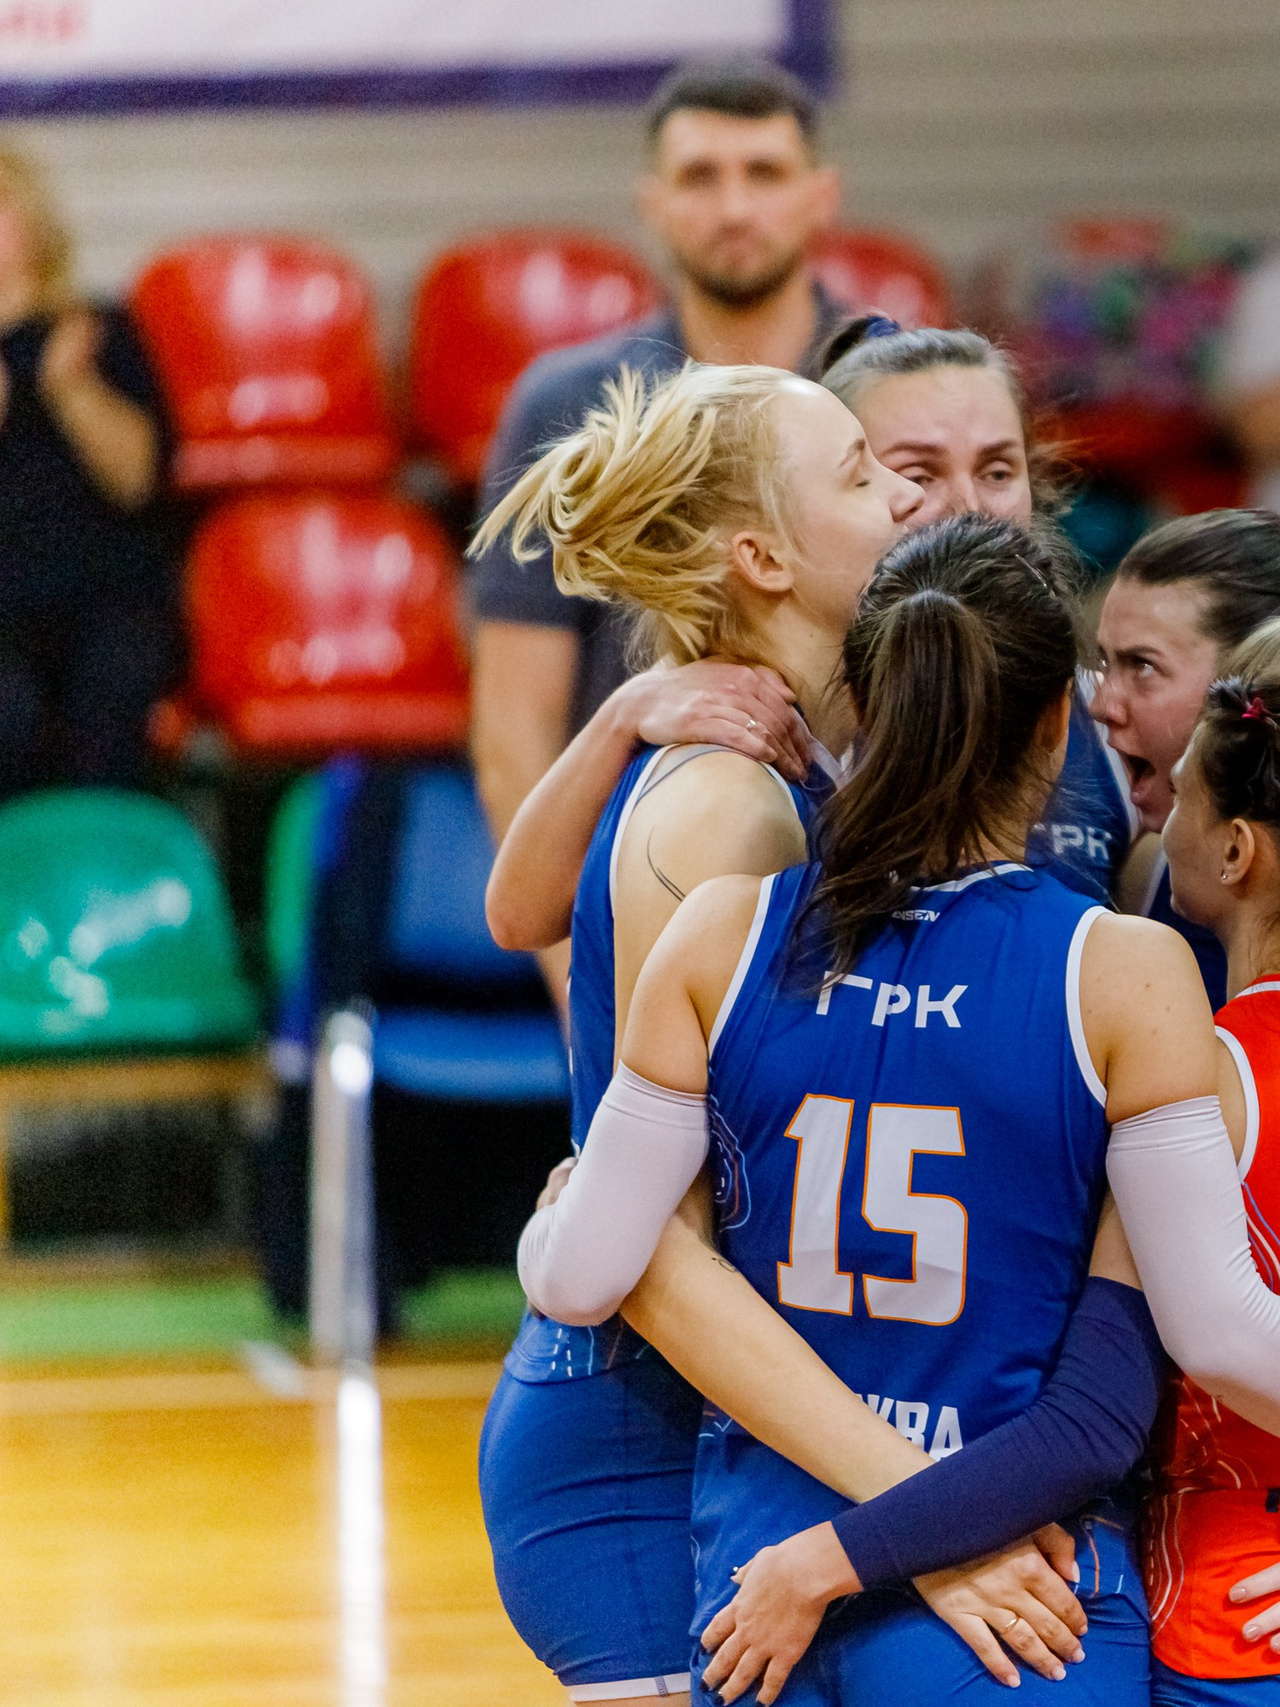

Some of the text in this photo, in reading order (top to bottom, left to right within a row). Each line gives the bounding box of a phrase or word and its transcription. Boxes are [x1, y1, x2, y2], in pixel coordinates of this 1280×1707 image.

[816, 970, 968, 1028] ГРК
[777, 1093, 968, 1327] 15
[855, 1393, 964, 1463] КВА
